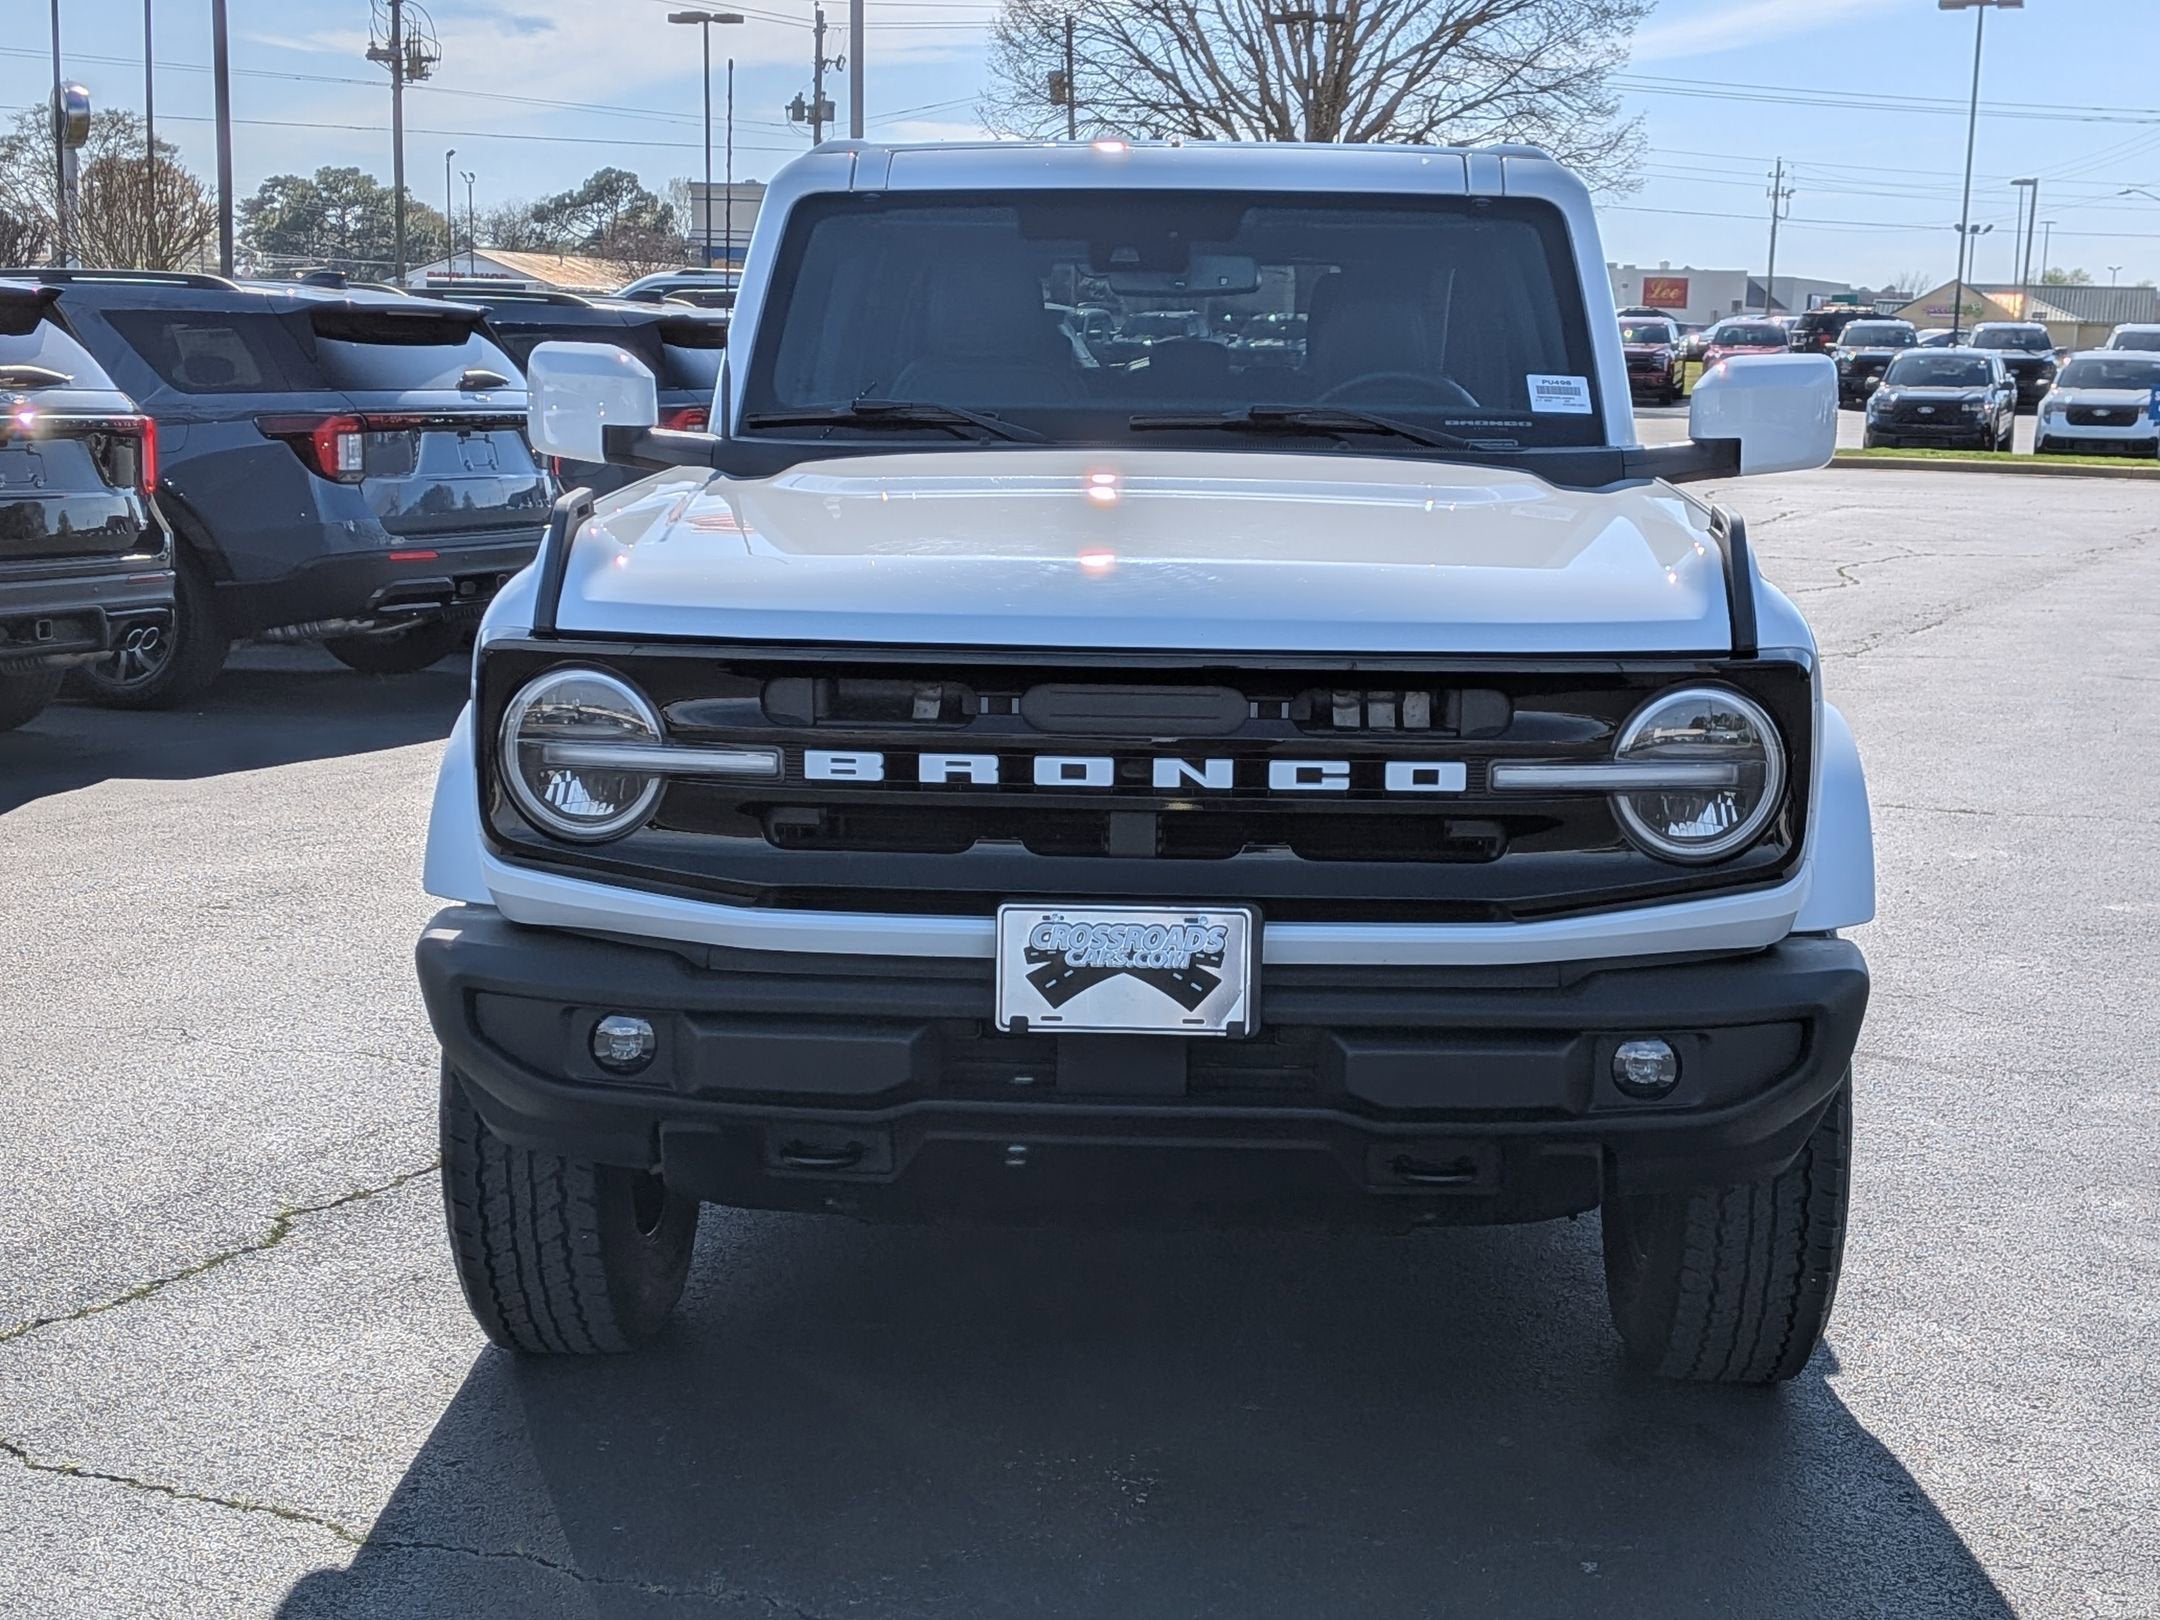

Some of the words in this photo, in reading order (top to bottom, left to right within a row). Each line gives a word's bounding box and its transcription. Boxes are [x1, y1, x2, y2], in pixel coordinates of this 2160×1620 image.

[1647, 280, 1681, 300] Lee
[803, 749, 1467, 793] BRONCO
[1029, 921, 1229, 954] CROSSROADS
[1064, 949, 1192, 969] CARS.COM
